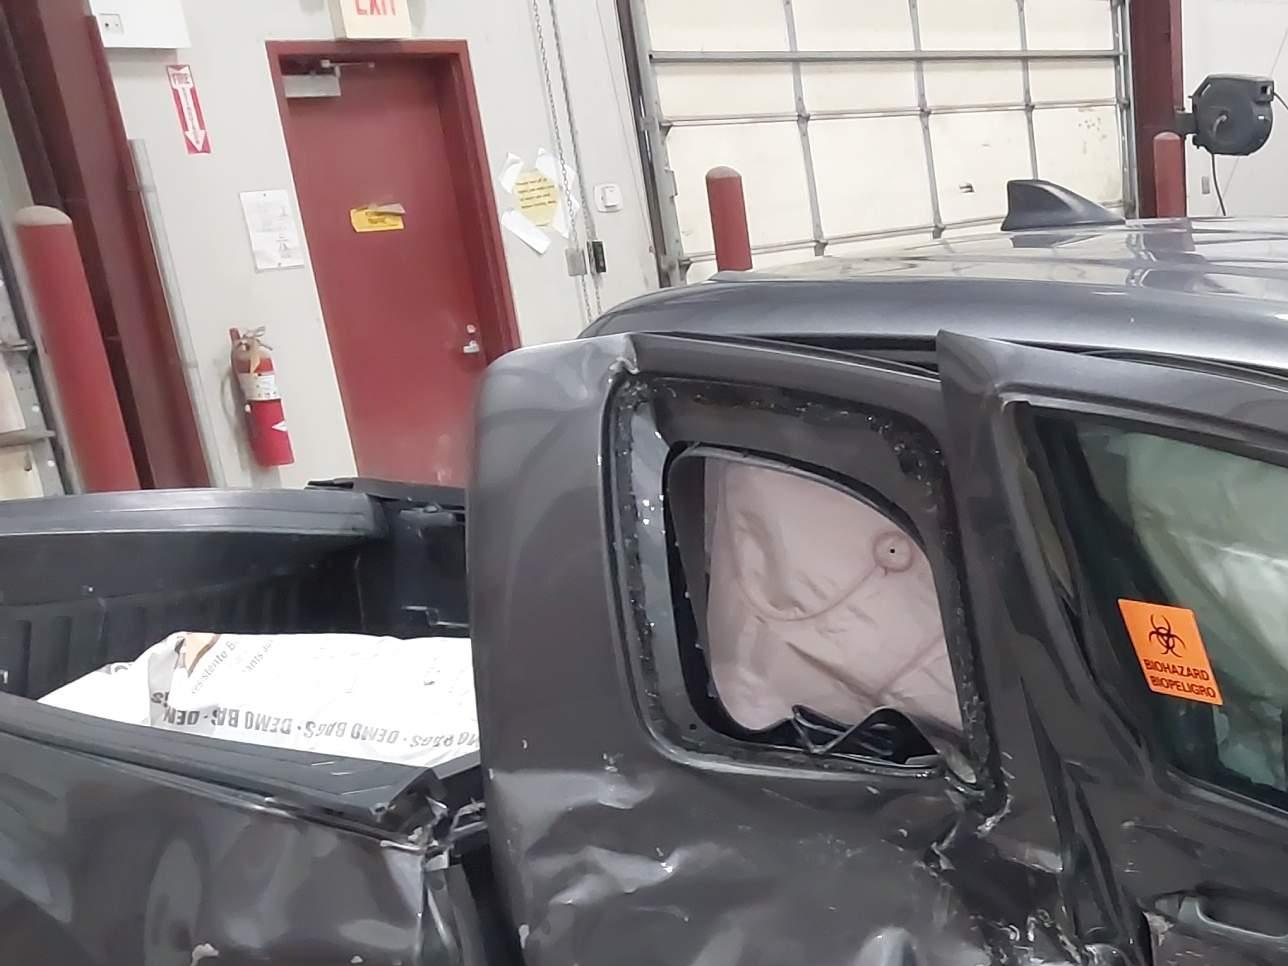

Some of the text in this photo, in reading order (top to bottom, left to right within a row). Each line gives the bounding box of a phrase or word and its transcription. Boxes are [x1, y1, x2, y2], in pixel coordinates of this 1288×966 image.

[1143, 658, 1210, 681] BIOHAZARD
[1149, 675, 1217, 698] BIOPELIGRO
[244, 711, 293, 735] DEMO
[304, 720, 347, 738] BAGS
[350, 723, 400, 745] DEMO
